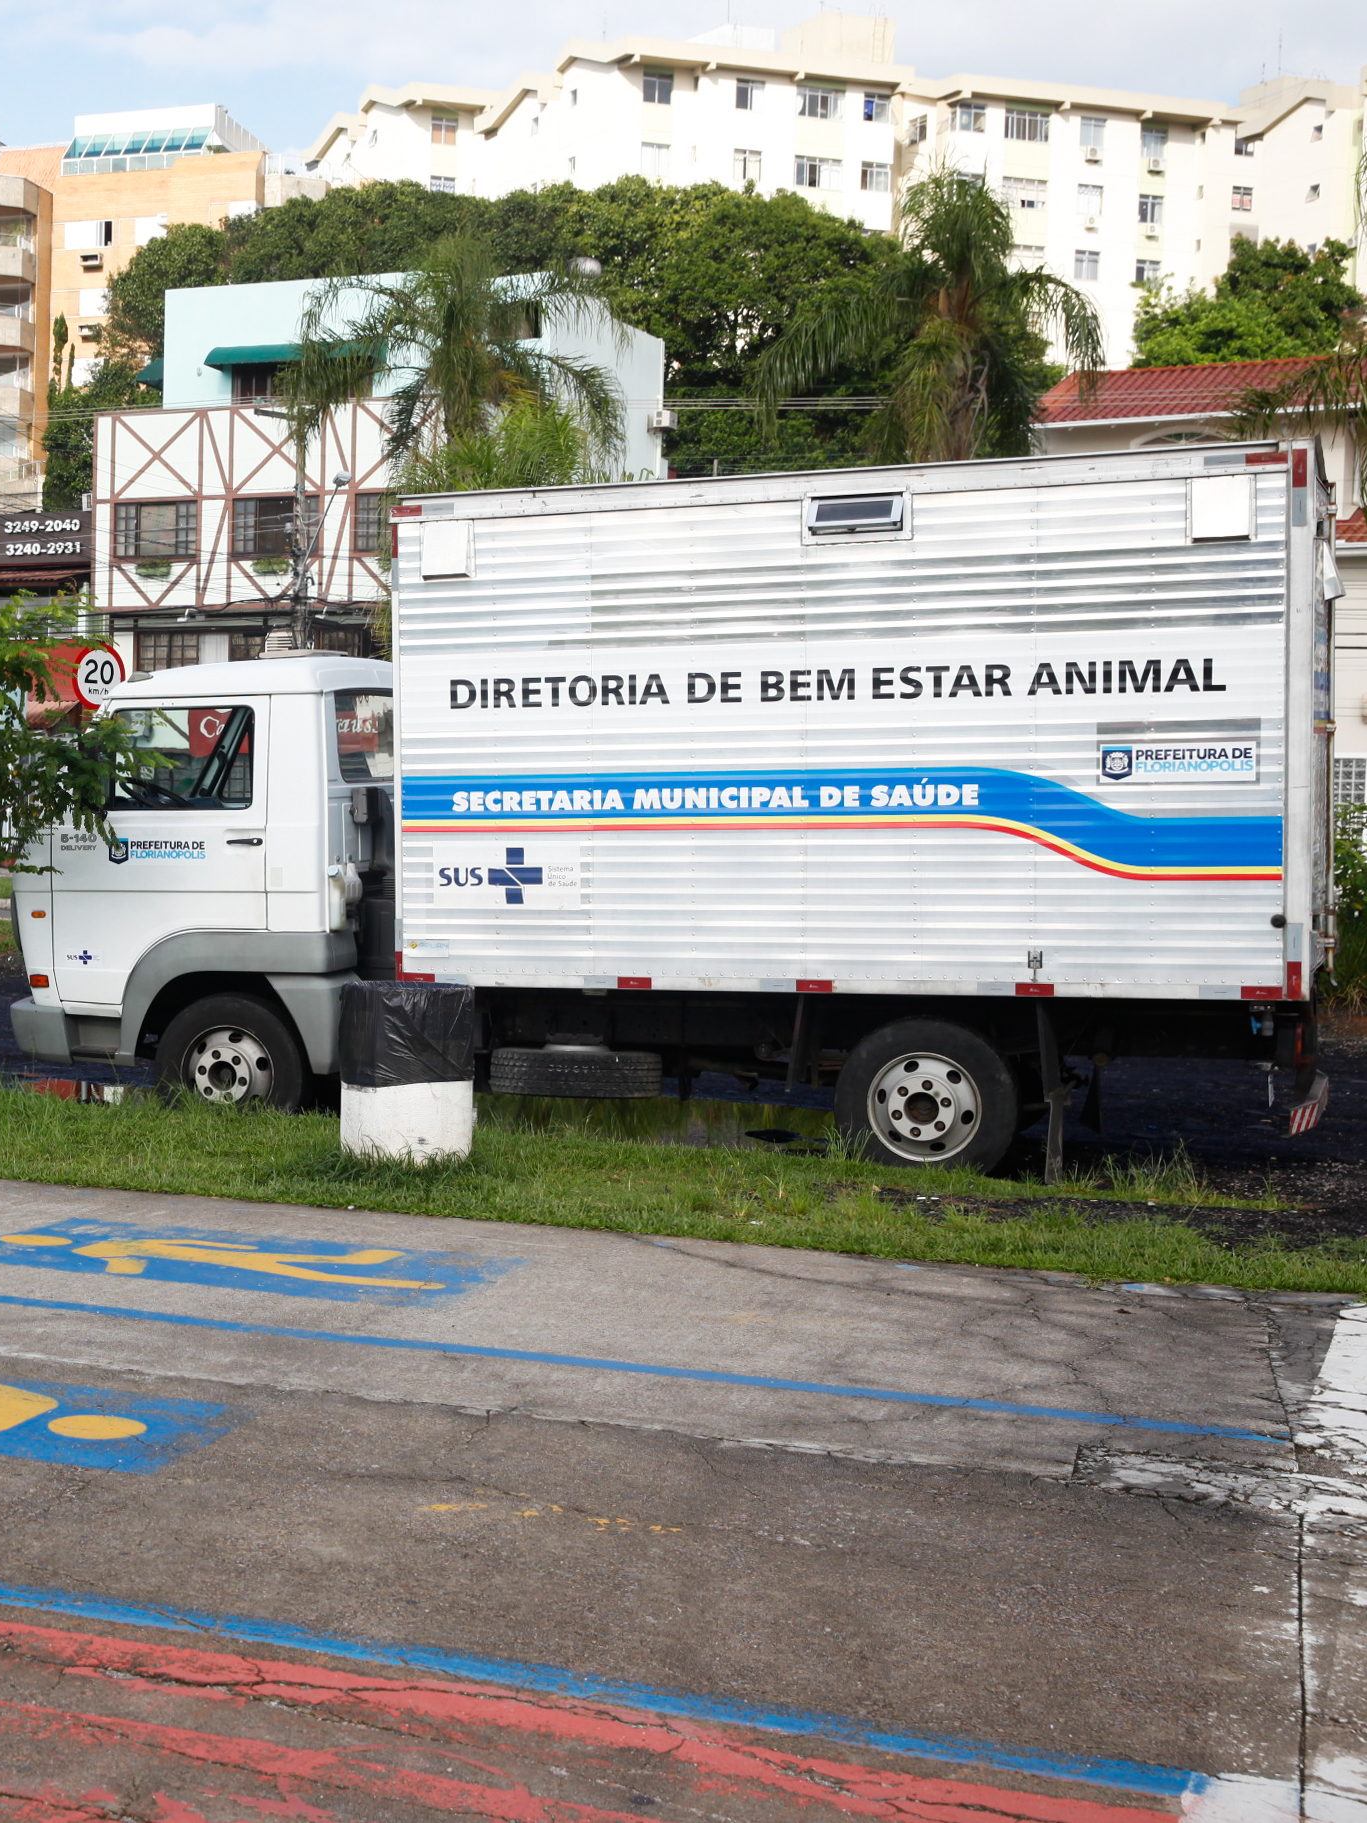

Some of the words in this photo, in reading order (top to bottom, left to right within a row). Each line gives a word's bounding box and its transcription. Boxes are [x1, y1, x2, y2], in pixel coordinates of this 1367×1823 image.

[4, 519, 80, 533] 3249-2040
[6, 541, 81, 556] 3240-2931
[84, 659, 114, 685] 20
[450, 673, 670, 709] DIRETORIA
[687, 671, 742, 704] DE
[760, 668, 856, 702] BEM
[872, 664, 1012, 700] ESTAR
[1027, 658, 1226, 696] ANIMAL
[88, 687, 109, 695] km/h
[1135, 748, 1229, 761] PREFEITURA
[1232, 747, 1252, 759] DE
[1135, 759, 1254, 773] FLORIANÓPOLIS
[452, 789, 624, 812] SECRETARIA
[633, 787, 809, 809] MUNICIPAL
[820, 786, 860, 807] DE
[870, 778, 979, 806] SAÚDE
[130, 840, 190, 850] PREFEITURA
[192, 841, 205, 850] DE
[130, 849, 206, 859] FLORIANÓPOLIS
[547, 865, 574, 873] Sistema
[438, 867, 483, 887] SUS
